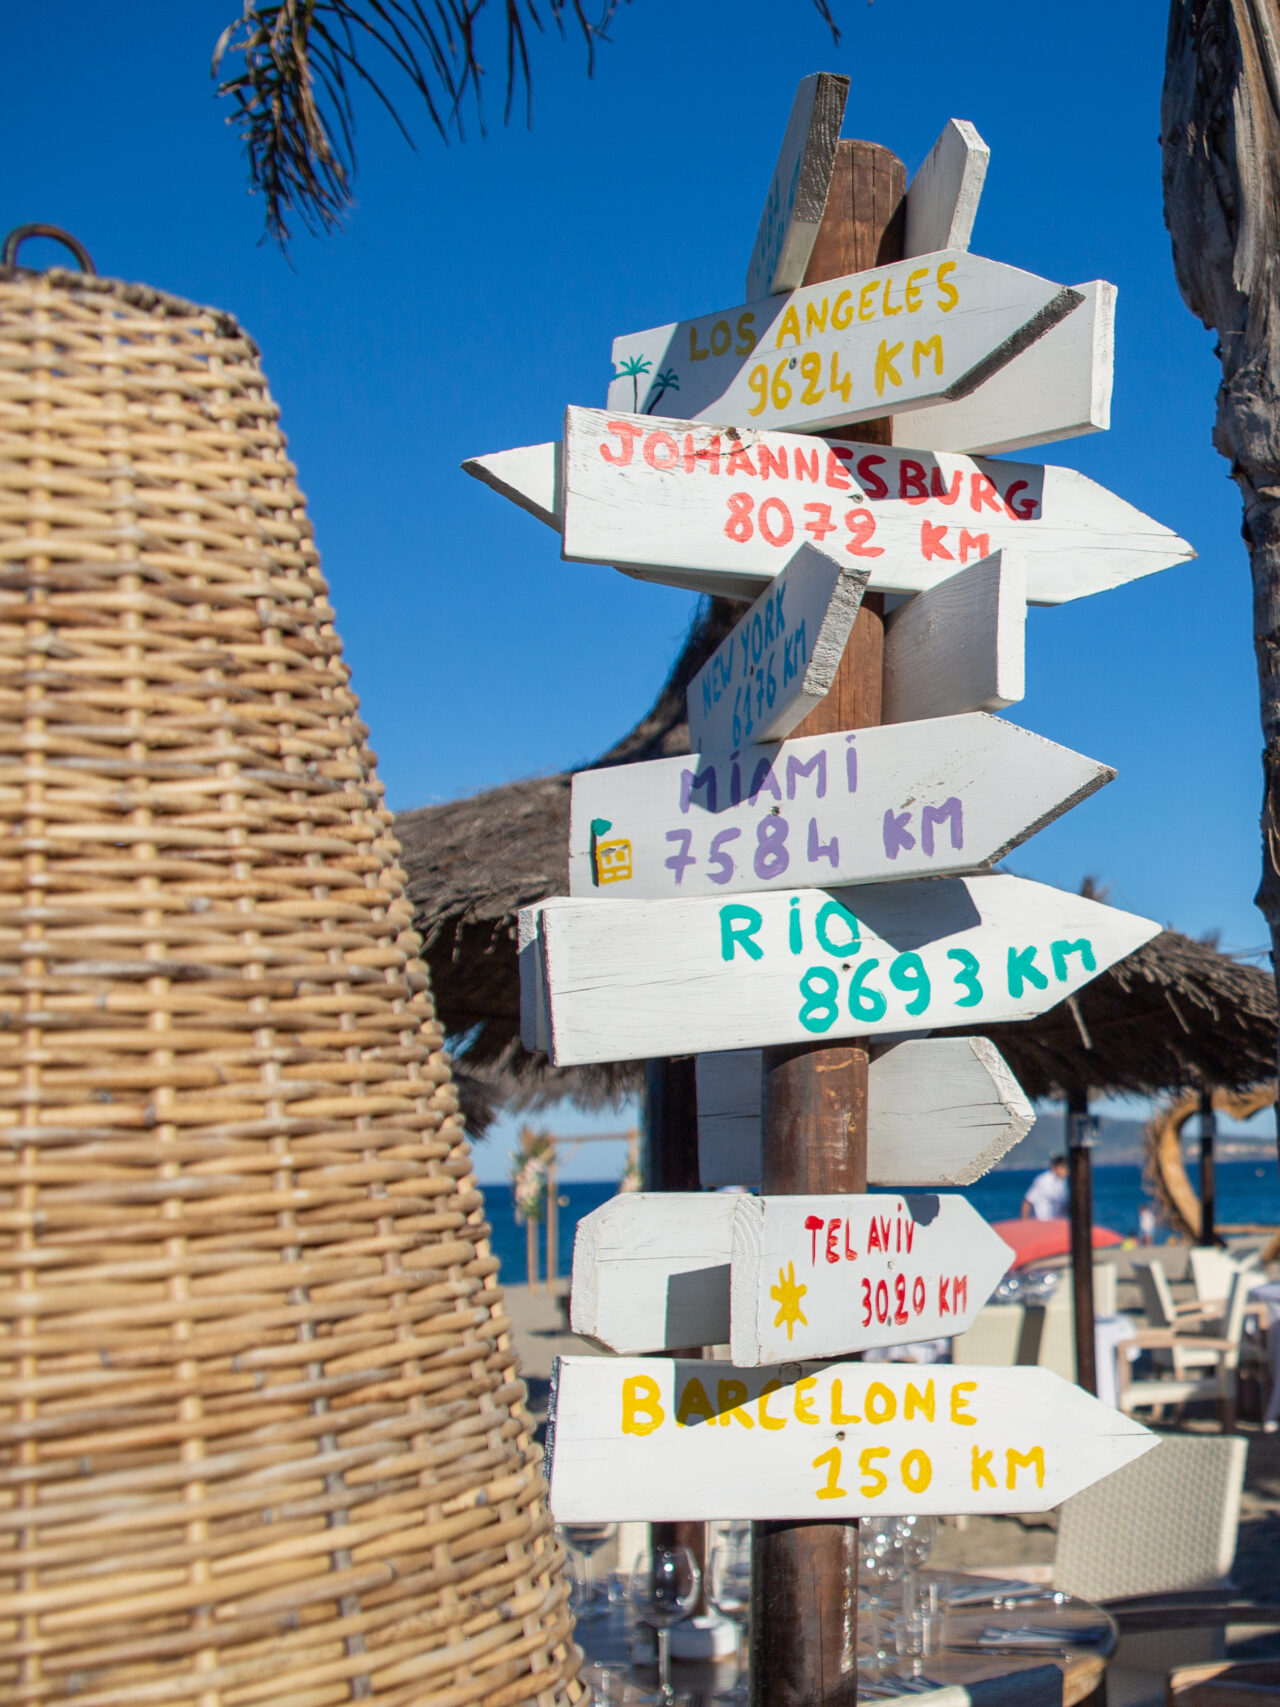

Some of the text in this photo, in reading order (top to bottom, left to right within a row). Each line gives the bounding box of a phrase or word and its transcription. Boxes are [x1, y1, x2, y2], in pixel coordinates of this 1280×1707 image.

[690, 261, 961, 362] LOS ANGELES
[746, 334, 945, 417] 9624 KM
[600, 422, 1039, 520] JOHANNESBURG
[724, 491, 990, 564] 8072 KM
[702, 580, 786, 720] NEW YORK
[733, 618, 806, 748] 6176 KM
[681, 734, 858, 814] MIAMI
[664, 796, 963, 885] 7584 KM
[720, 897, 862, 962] RIO
[797, 938, 1097, 1034] 8693 KM
[806, 1202, 915, 1266] TEL AVIV
[861, 1275, 968, 1328] 3020 KM
[622, 1374, 979, 1437] BARCELONE
[813, 1446, 1046, 1501] 150 KM
